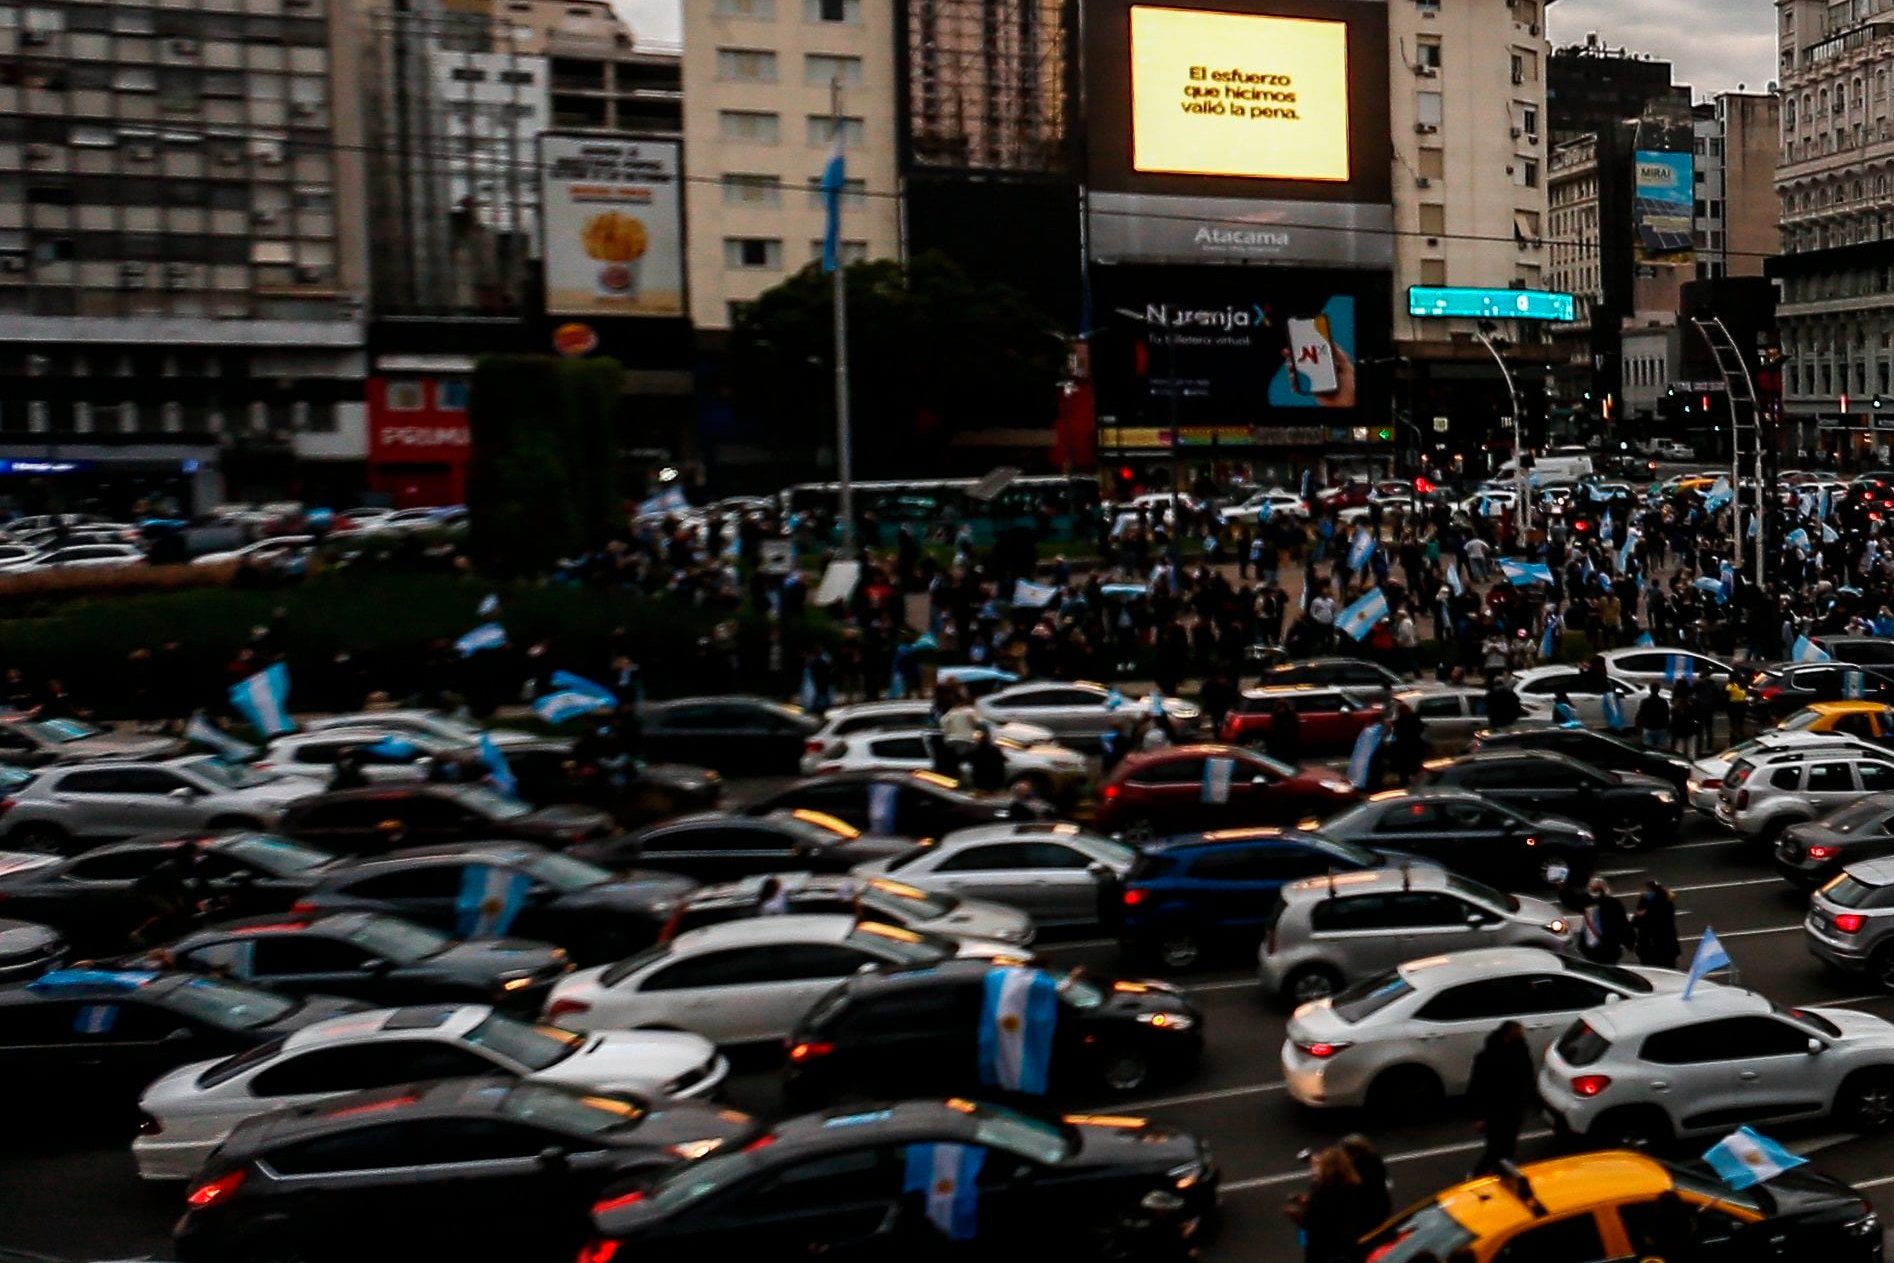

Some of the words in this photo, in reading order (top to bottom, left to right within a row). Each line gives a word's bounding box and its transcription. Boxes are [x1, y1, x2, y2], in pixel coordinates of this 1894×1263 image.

[1189, 66, 1207, 81] El
[1211, 68, 1291, 86] esfuerzo
[1184, 85, 1220, 99] que
[1225, 85, 1296, 103] hicimos
[1181, 100, 1226, 115] valió
[1230, 102, 1245, 116] la
[1250, 105, 1300, 120] pena.
[1194, 227, 1289, 246] Atacama
